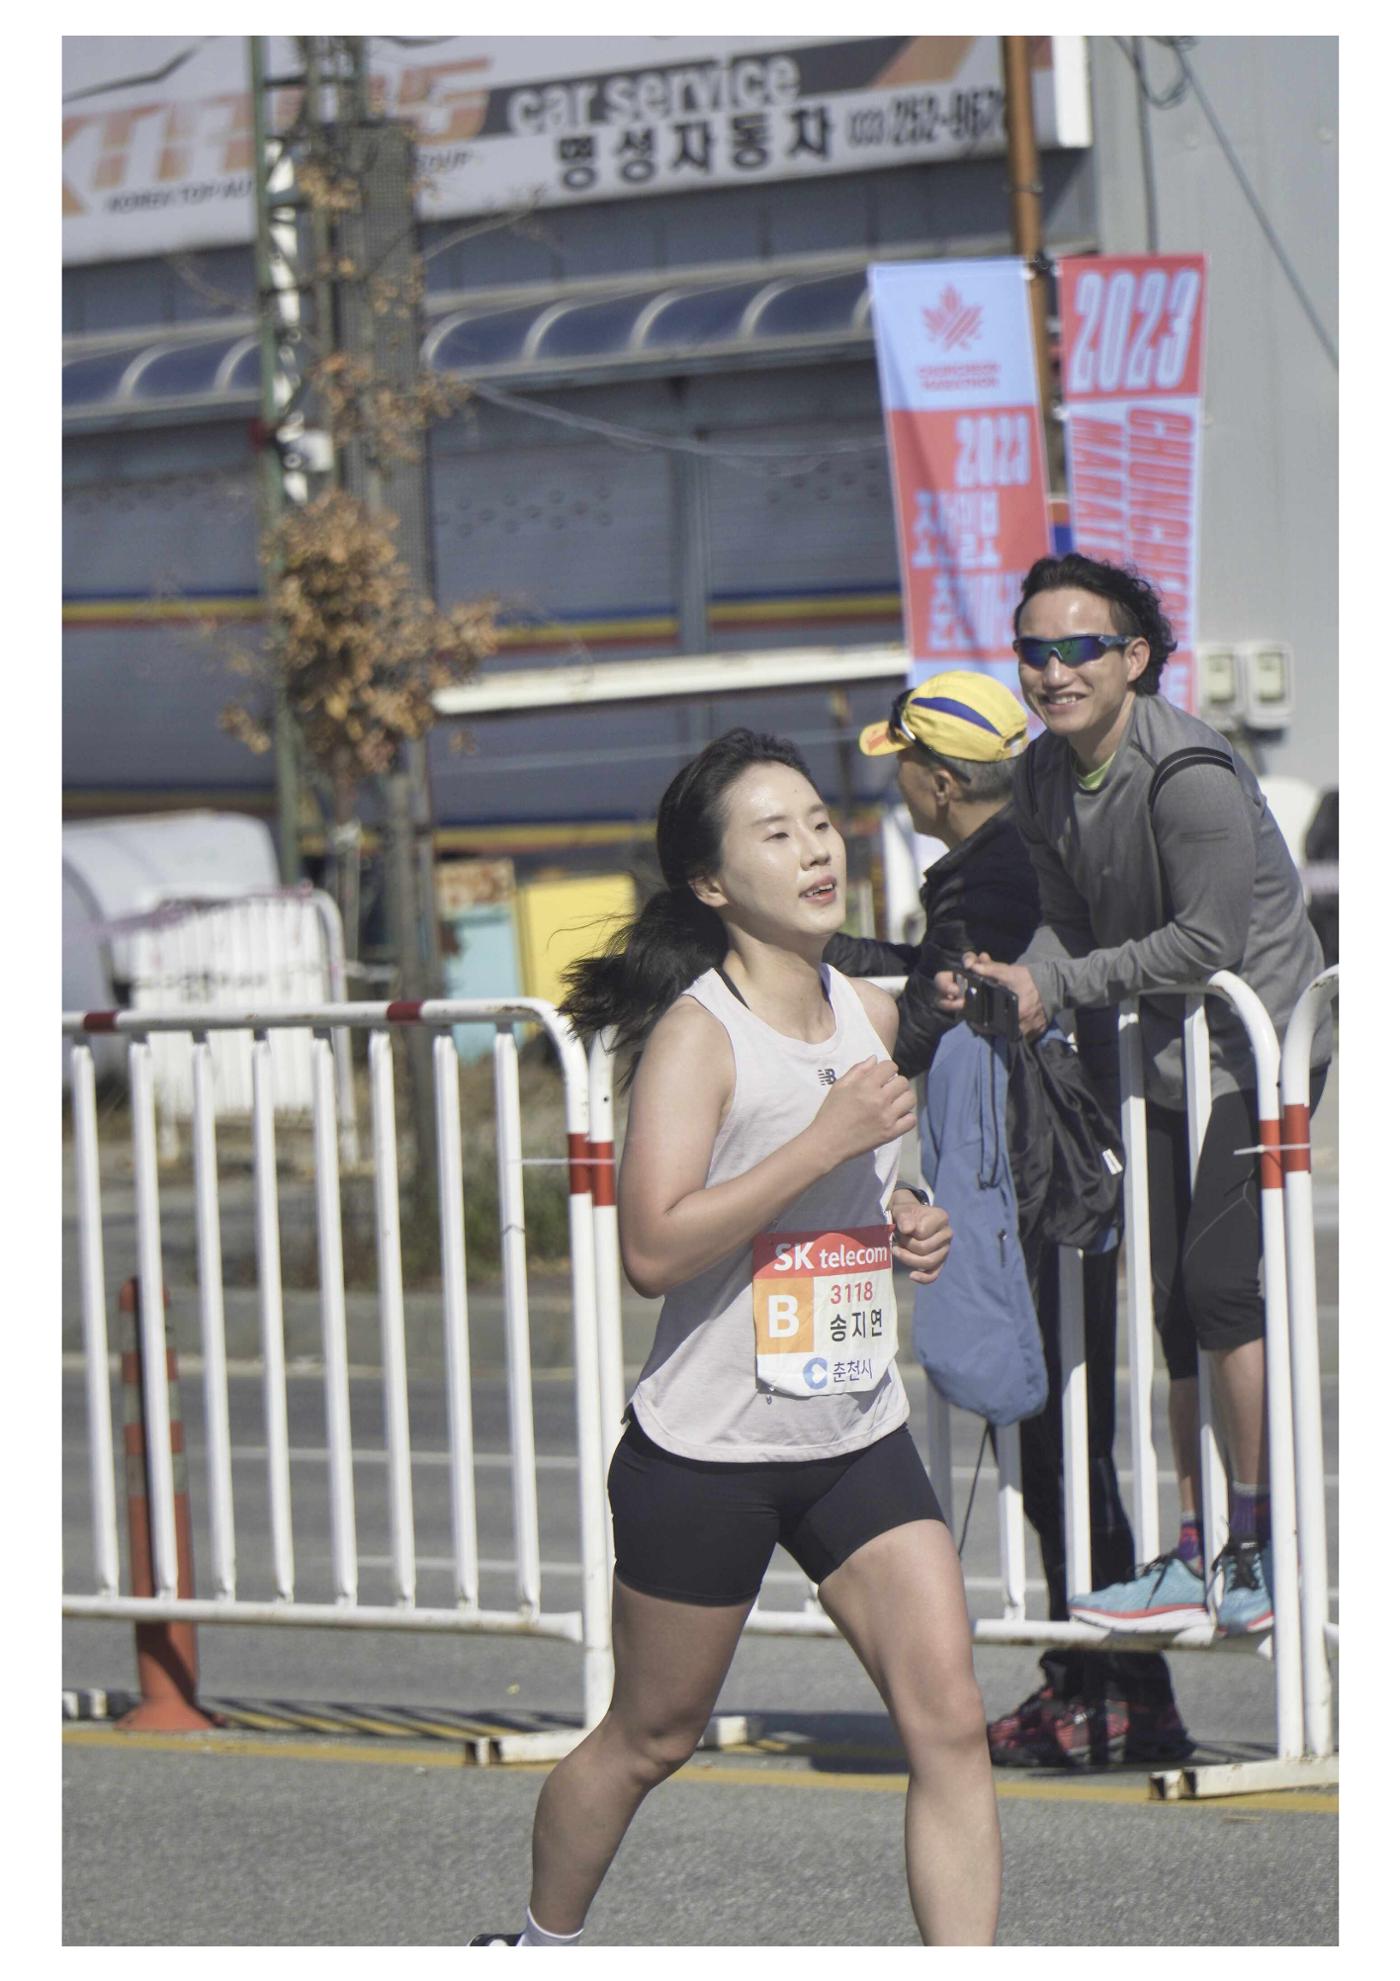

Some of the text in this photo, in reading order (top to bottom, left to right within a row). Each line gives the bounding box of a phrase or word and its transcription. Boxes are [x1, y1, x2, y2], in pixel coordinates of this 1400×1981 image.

[507, 80, 595, 136] car
[604, 54, 802, 122] service
[556, 105, 832, 193] 명성자동차
[1069, 269, 1199, 392] 2023
[773, 1242, 888, 1272] SK telecom
[830, 1281, 874, 1305] 3118
[767, 1295, 800, 1339] B
[829, 1308, 884, 1343] 송지연
[832, 1358, 873, 1384] 춘천시
